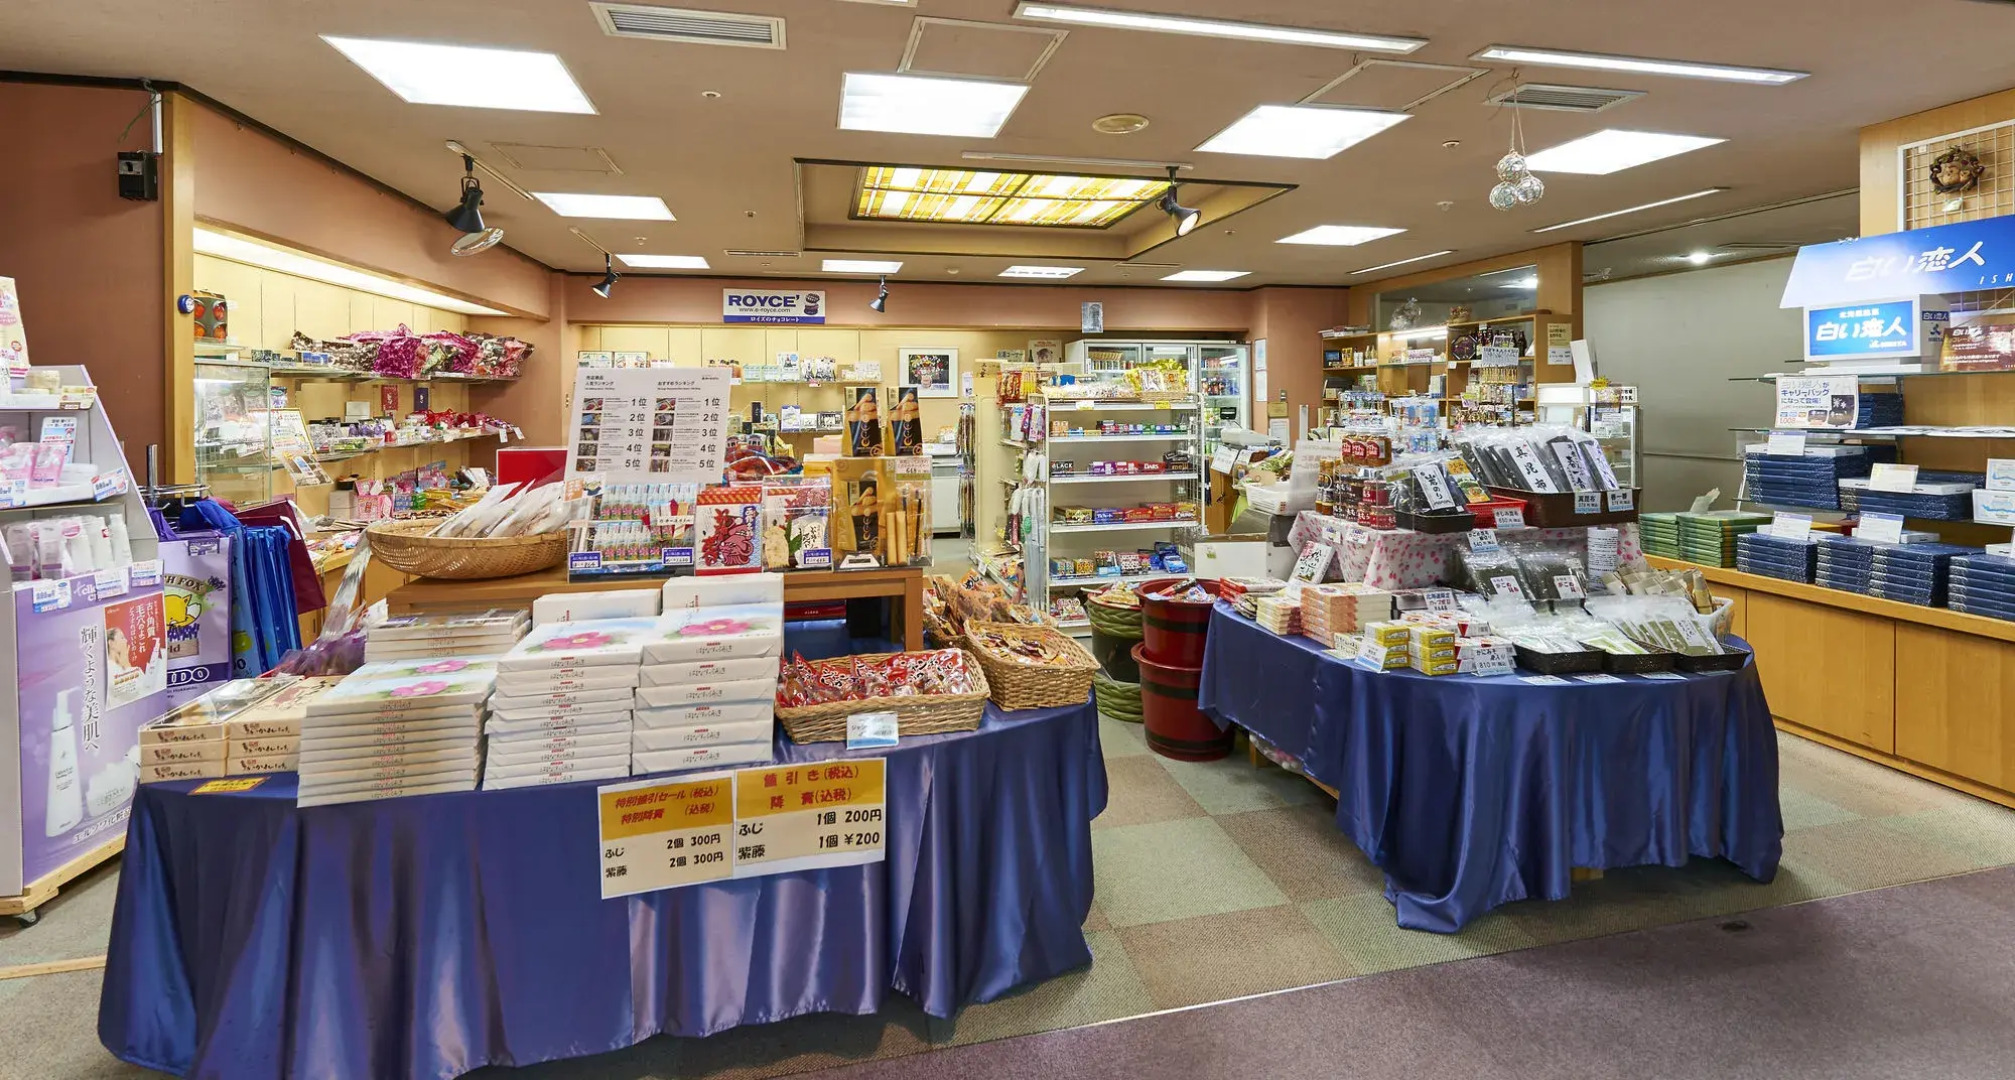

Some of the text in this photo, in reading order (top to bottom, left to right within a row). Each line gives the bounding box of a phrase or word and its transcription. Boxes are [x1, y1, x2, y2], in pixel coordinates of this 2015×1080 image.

[728, 294, 800, 307] ROYCE'
[1816, 316, 1907, 341] 白い恋人
[178, 577, 204, 591] FOX
[167, 666, 210, 686] IDO
[81, 626, 100, 750] 輝くような美肌へ
[739, 809, 882, 836] ふじ 1個 200円
[605, 833, 721, 858] ふじ 2個 300円
[819, 834, 838, 848] 1個
[844, 831, 880, 845] ¥200
[669, 856, 687, 868] 2個
[693, 851, 724, 865] 300円
